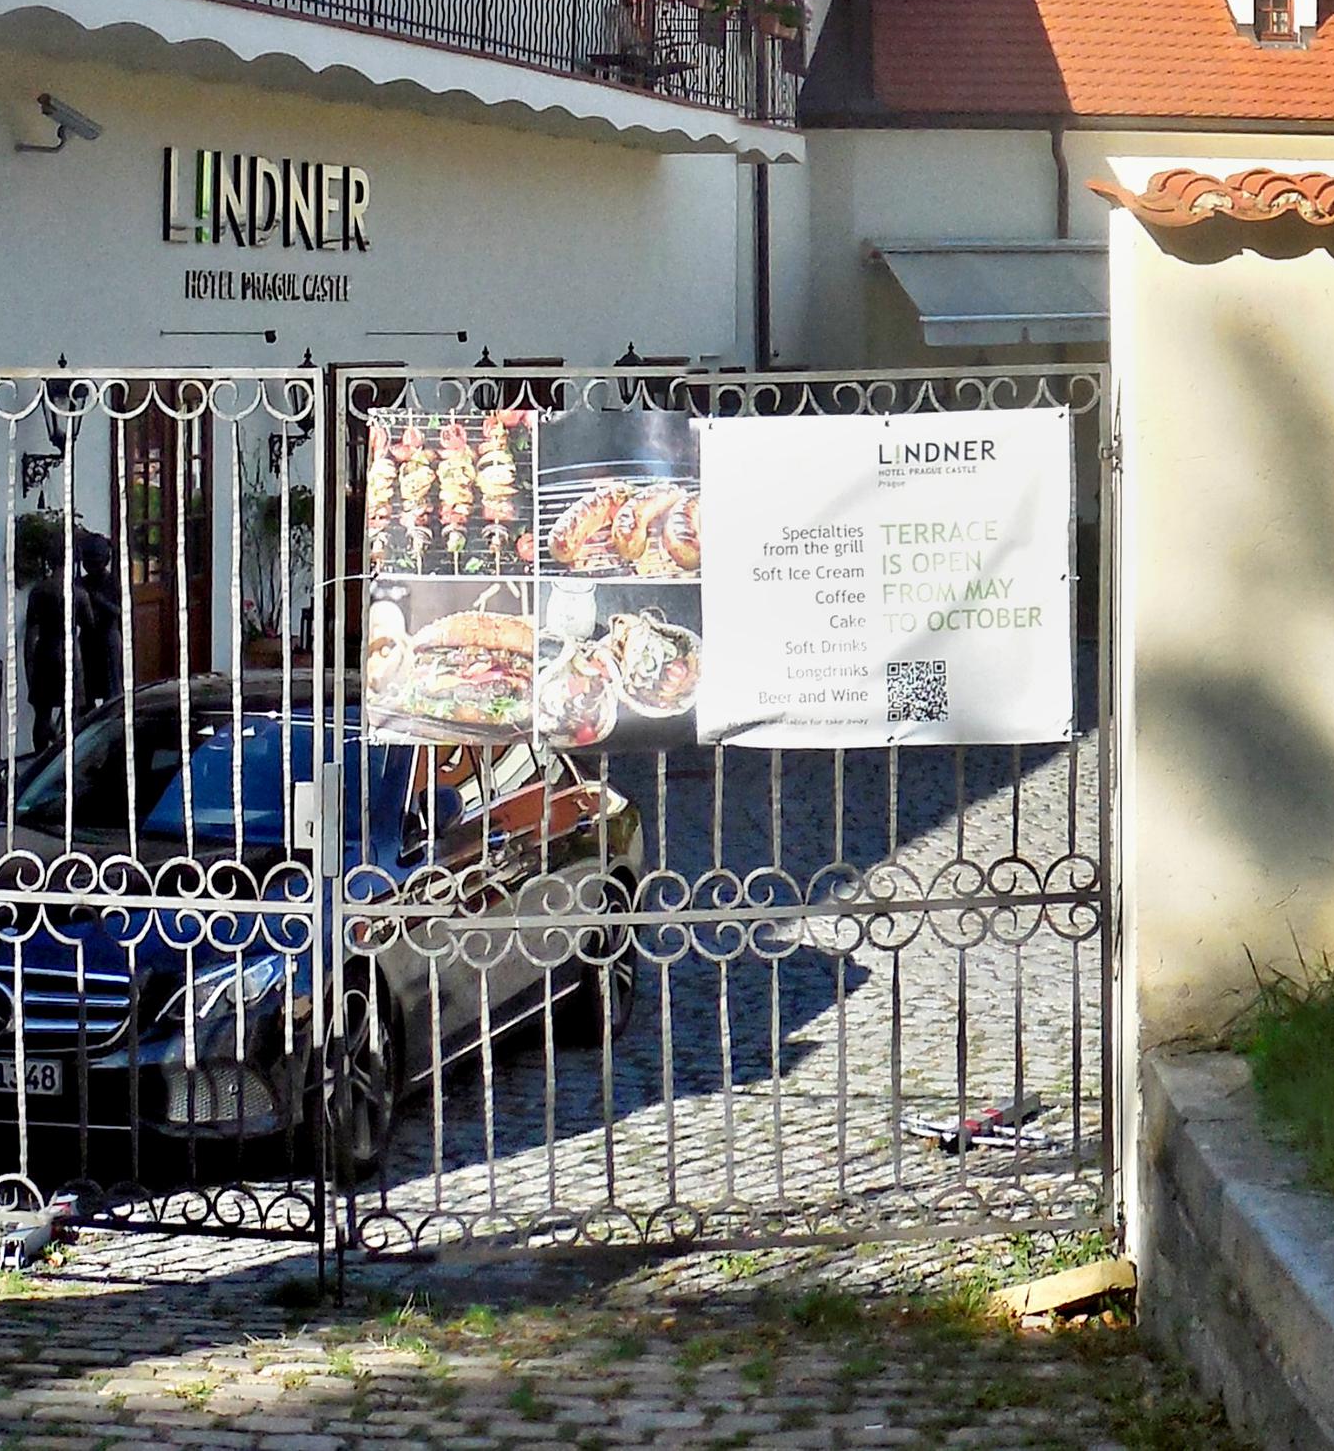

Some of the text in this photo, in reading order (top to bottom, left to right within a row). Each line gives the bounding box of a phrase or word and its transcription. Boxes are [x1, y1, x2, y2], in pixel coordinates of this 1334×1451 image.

[878, 465, 978, 477] HOTEL PRAGUE CASTLE
[782, 524, 864, 543] Specialties
[880, 520, 999, 545] TERRACE
[763, 539, 864, 557] from the grill
[882, 551, 982, 575] IS OPEN
[752, 565, 865, 581] Soft Ice Cream
[815, 589, 866, 605] Coffee
[882, 578, 1014, 605] FROM MAY
[829, 614, 867, 629] Cake
[882, 606, 1043, 633] TO OCTOBER
[785, 639, 868, 655] Soft Drinks
[787, 664, 869, 681] Longdrinks
[758, 688, 868, 705] Beer and Wine
